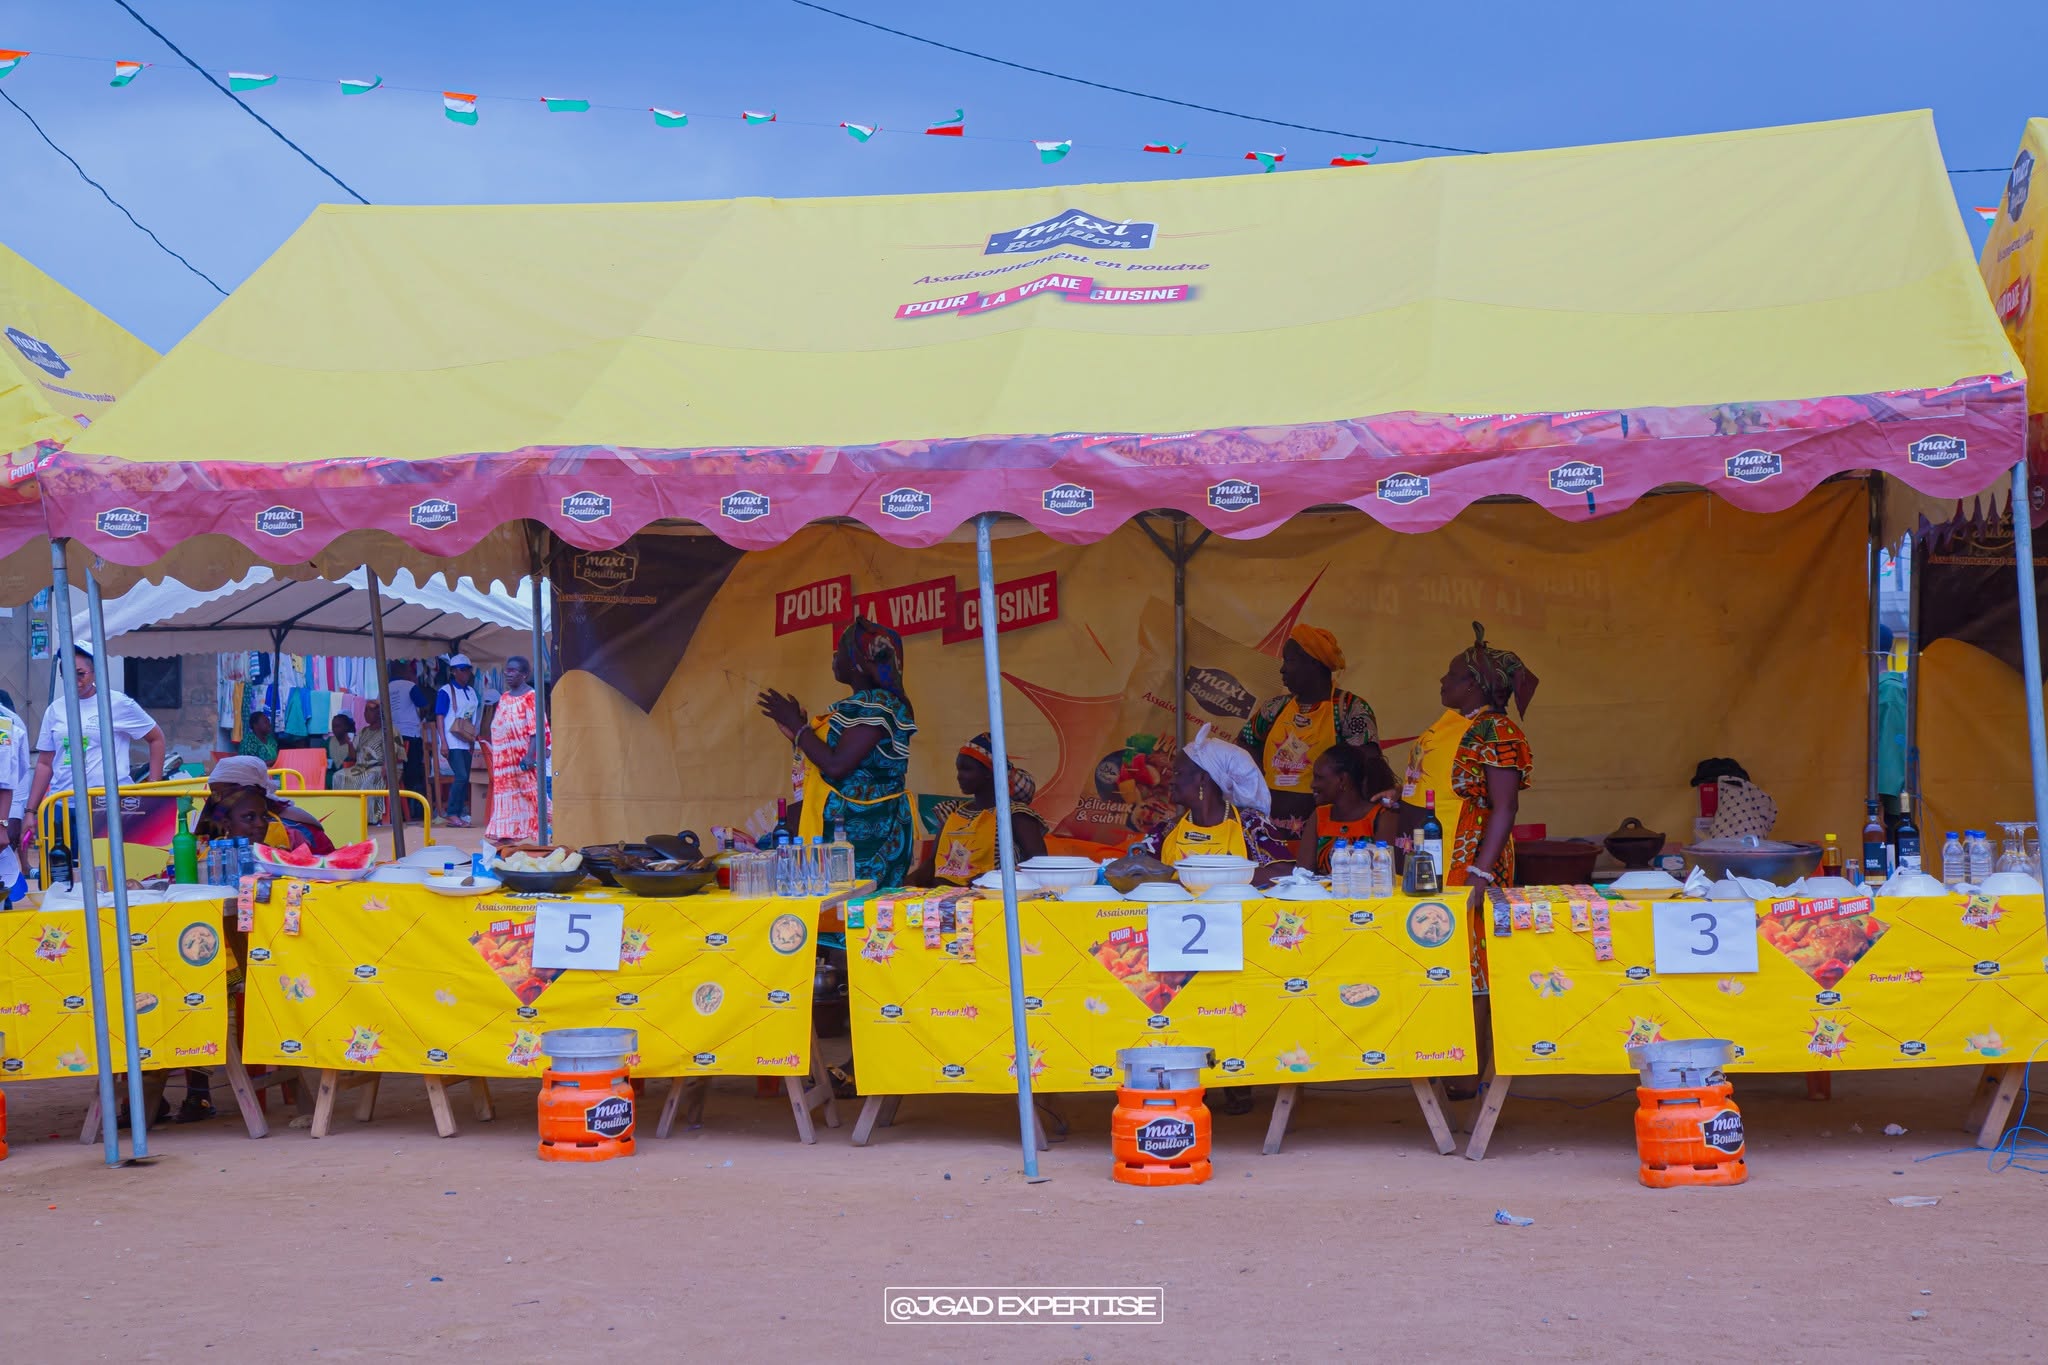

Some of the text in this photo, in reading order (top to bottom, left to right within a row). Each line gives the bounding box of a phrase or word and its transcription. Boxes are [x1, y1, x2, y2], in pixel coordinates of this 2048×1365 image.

[1013, 215, 1133, 239] maxi
[1003, 228, 1131, 253] Bouillon
[913, 252, 1210, 285] Assaisonnement en poudre
[904, 276, 1179, 315] POUR LA VRAIE CUISINE
[1918, 436, 1957, 451] maxi
[1734, 451, 1772, 465] maxi
[1917, 451, 1960, 462] Bouillon
[11, 461, 35, 480] POUR
[1557, 464, 1594, 479] maxi
[1733, 465, 1775, 476] Bouillon
[1216, 482, 1252, 494] maxi
[1384, 475, 1422, 488] maxi
[1556, 476, 1597, 488] Bouillon
[729, 493, 762, 505] maxi
[888, 491, 924, 503] maxi
[1051, 486, 1086, 499] maxi
[1384, 487, 1423, 498] Bouillon
[570, 494, 604, 506] maxi
[1050, 499, 1088, 509] Bouillon
[1214, 495, 1253, 505] Bouillon
[418, 501, 450, 514] maxi
[568, 505, 605, 516] Bouillon
[727, 505, 764, 515] Bouillon
[887, 503, 925, 513] Bouillon
[105, 510, 140, 523] maxi
[264, 509, 295, 521] maxi
[416, 513, 452, 524] Bouillon
[104, 522, 142, 532] Bouillon
[262, 520, 297, 530] Bouillon
[585, 553, 626, 566] maxi
[583, 568, 627, 579] Bouillon
[782, 582, 842, 625] POUR
[889, 587, 947, 627] VRAIE
[963, 583, 1051, 631] CSINE
[1197, 670, 1246, 700] maxi
[1190, 682, 1242, 716] Bouillon
[1773, 899, 1869, 916] POUR LA VRAIE CUISINE
[491, 921, 522, 936] POUR LA
[565, 914, 591, 953] 5
[1182, 914, 1208, 954] 2
[1690, 912, 1720, 955] 3
[1111, 928, 1144, 943] POUR LA
[595, 1098, 629, 1118] maxi
[594, 1116, 630, 1130] Bouillon
[1146, 1120, 1187, 1137] maxi
[1145, 1138, 1189, 1150] Bouillon
